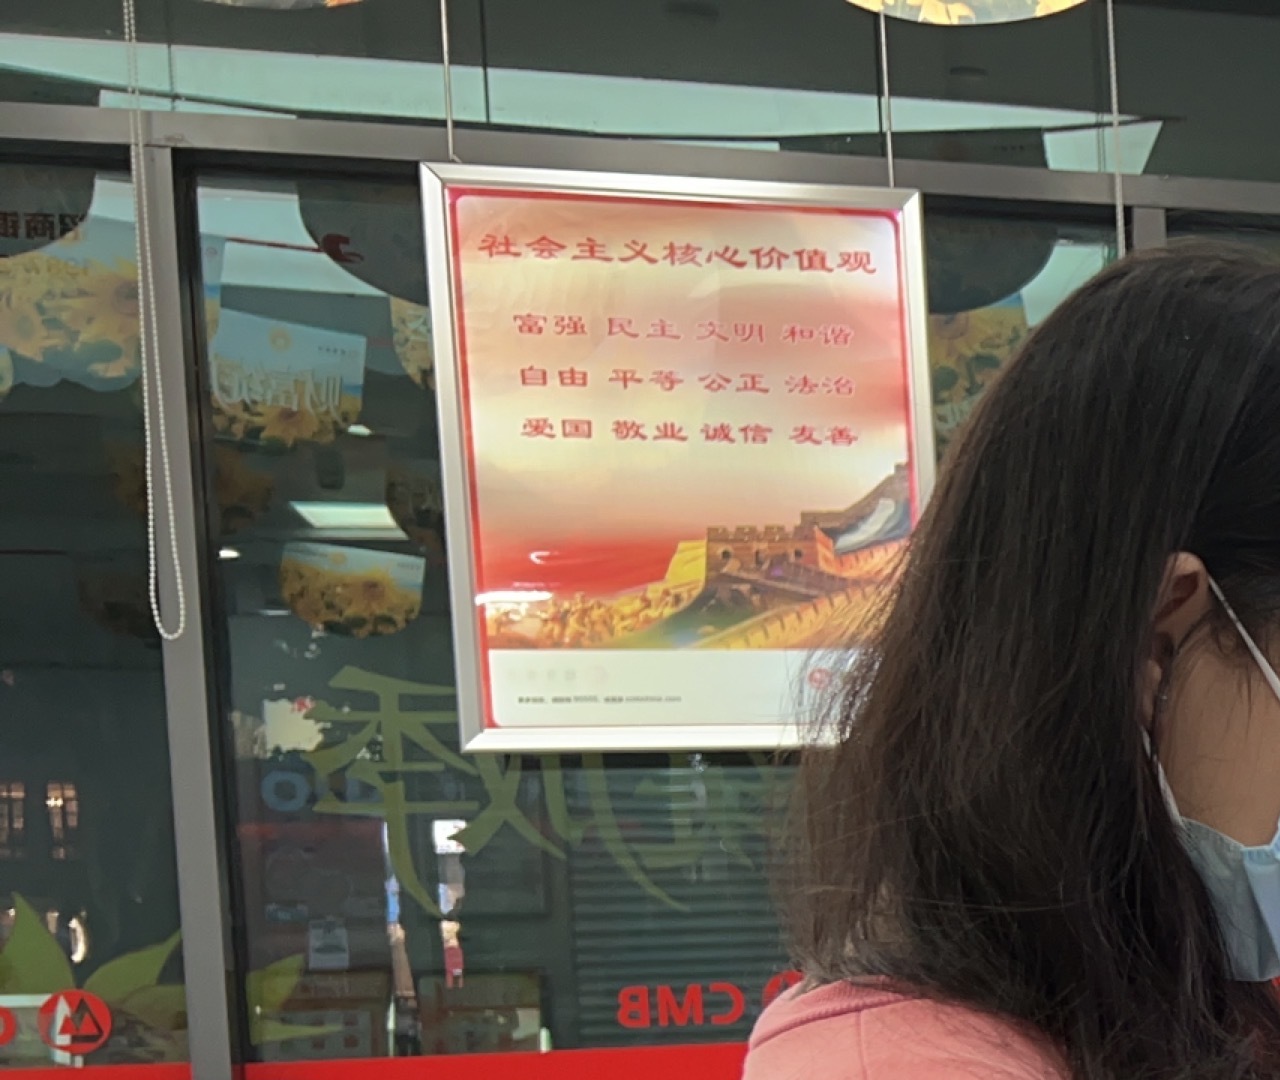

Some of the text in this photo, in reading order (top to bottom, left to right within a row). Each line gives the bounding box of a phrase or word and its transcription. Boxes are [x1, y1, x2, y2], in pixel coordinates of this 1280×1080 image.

[478, 233, 877, 275] 社会主义核心价值观
[513, 313, 853, 348] 富强 民主 文明 和谐
[519, 365, 856, 397] 自由 平等 公正 法治
[520, 417, 859, 447] 爱国 敬业 诚信 友善
